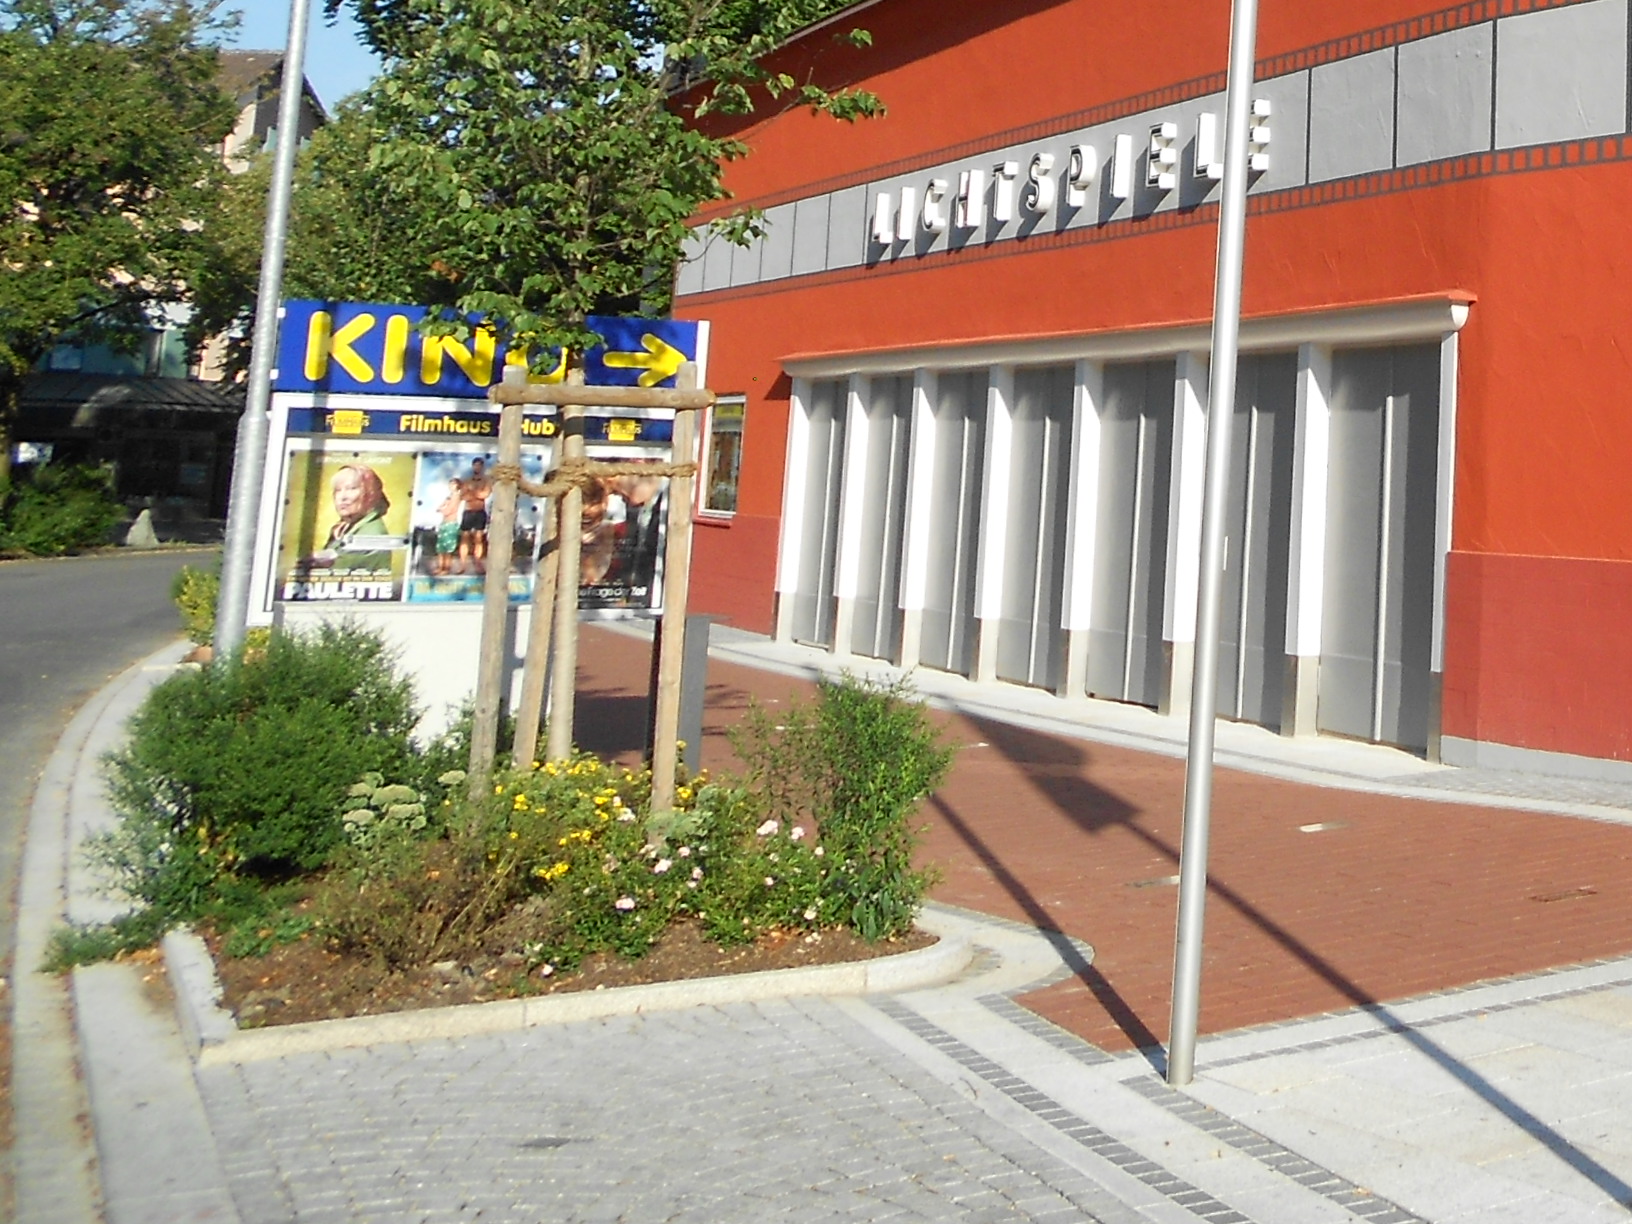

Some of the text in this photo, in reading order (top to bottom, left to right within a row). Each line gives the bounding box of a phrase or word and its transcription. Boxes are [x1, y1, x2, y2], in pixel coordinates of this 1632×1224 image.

[872, 98, 1271, 244] LICHTSPIELE
[400, 414, 558, 436] Filmhaus Hub
[283, 581, 393, 599] PAULETTE
